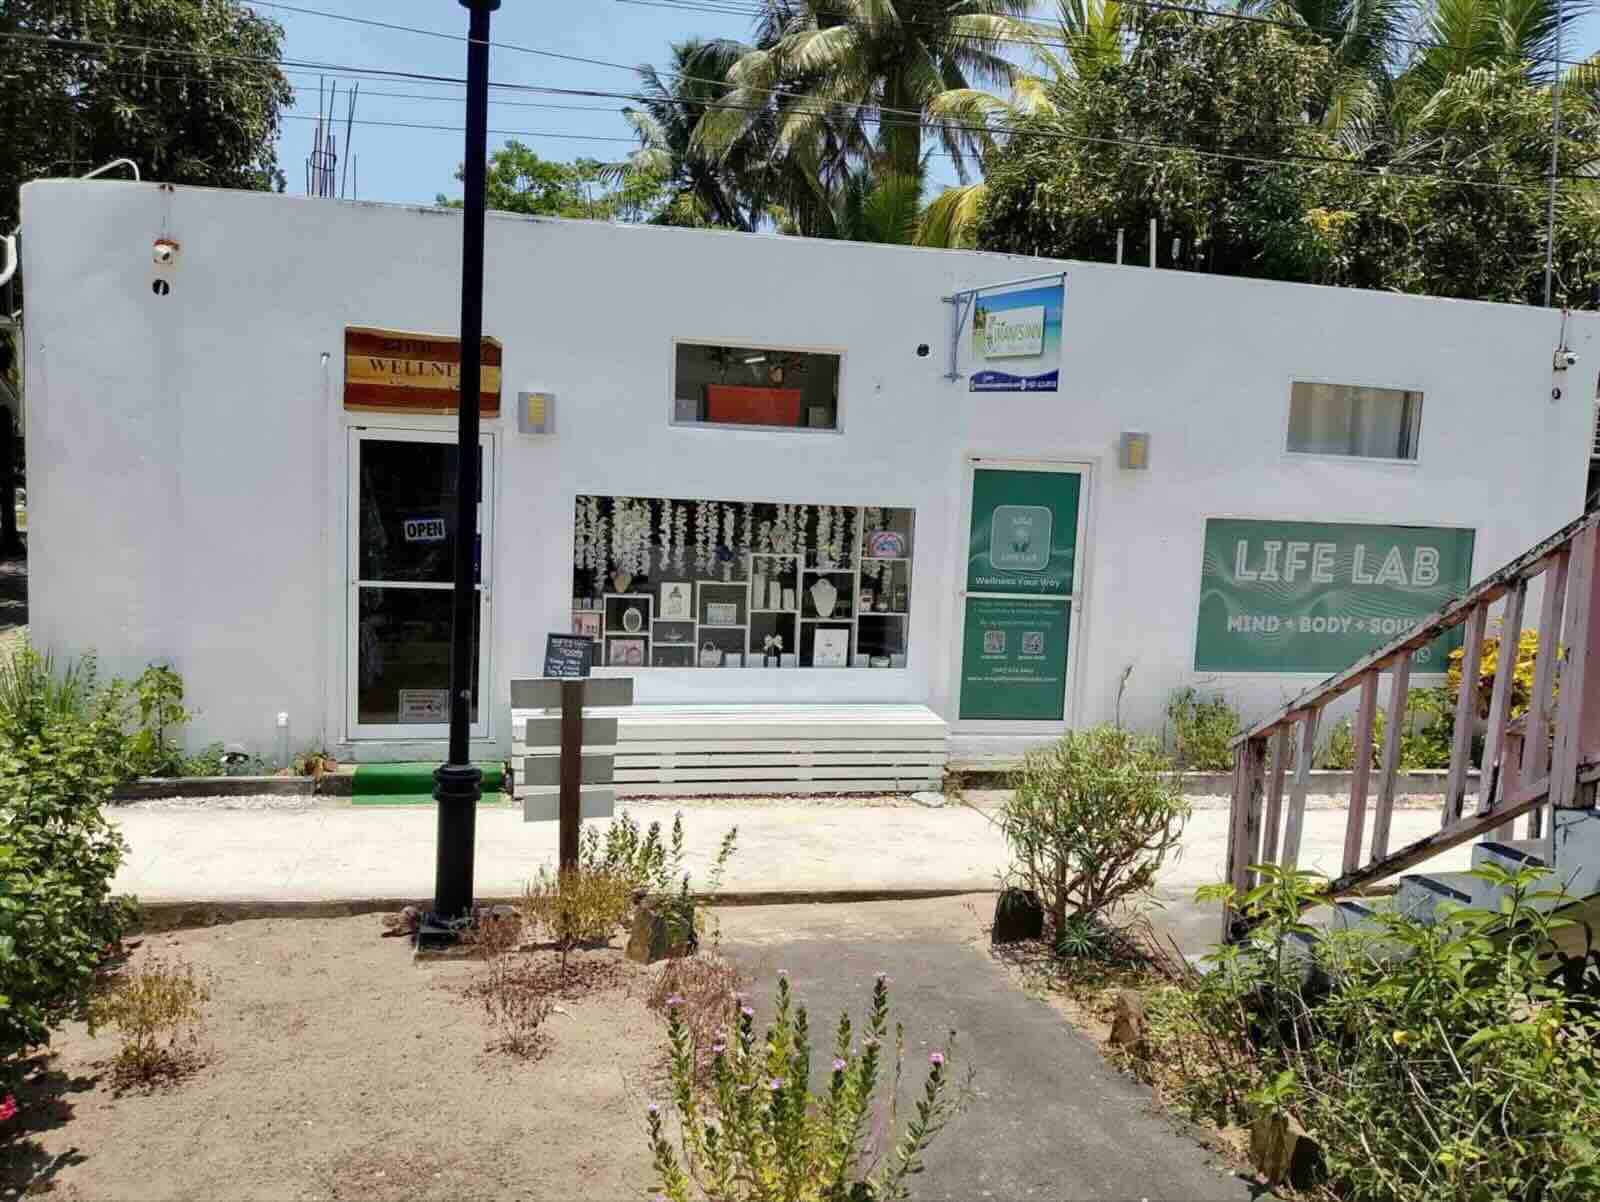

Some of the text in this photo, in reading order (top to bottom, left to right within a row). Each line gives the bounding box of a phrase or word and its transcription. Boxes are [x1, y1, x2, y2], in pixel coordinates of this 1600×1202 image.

[407, 521, 444, 538] OPEN
[1234, 539, 1441, 586] LIFE LAB
[975, 575, 1061, 591] Wellness Your Way
[1227, 614, 1280, 633] MIND
[1299, 615, 1352, 633] BODY
